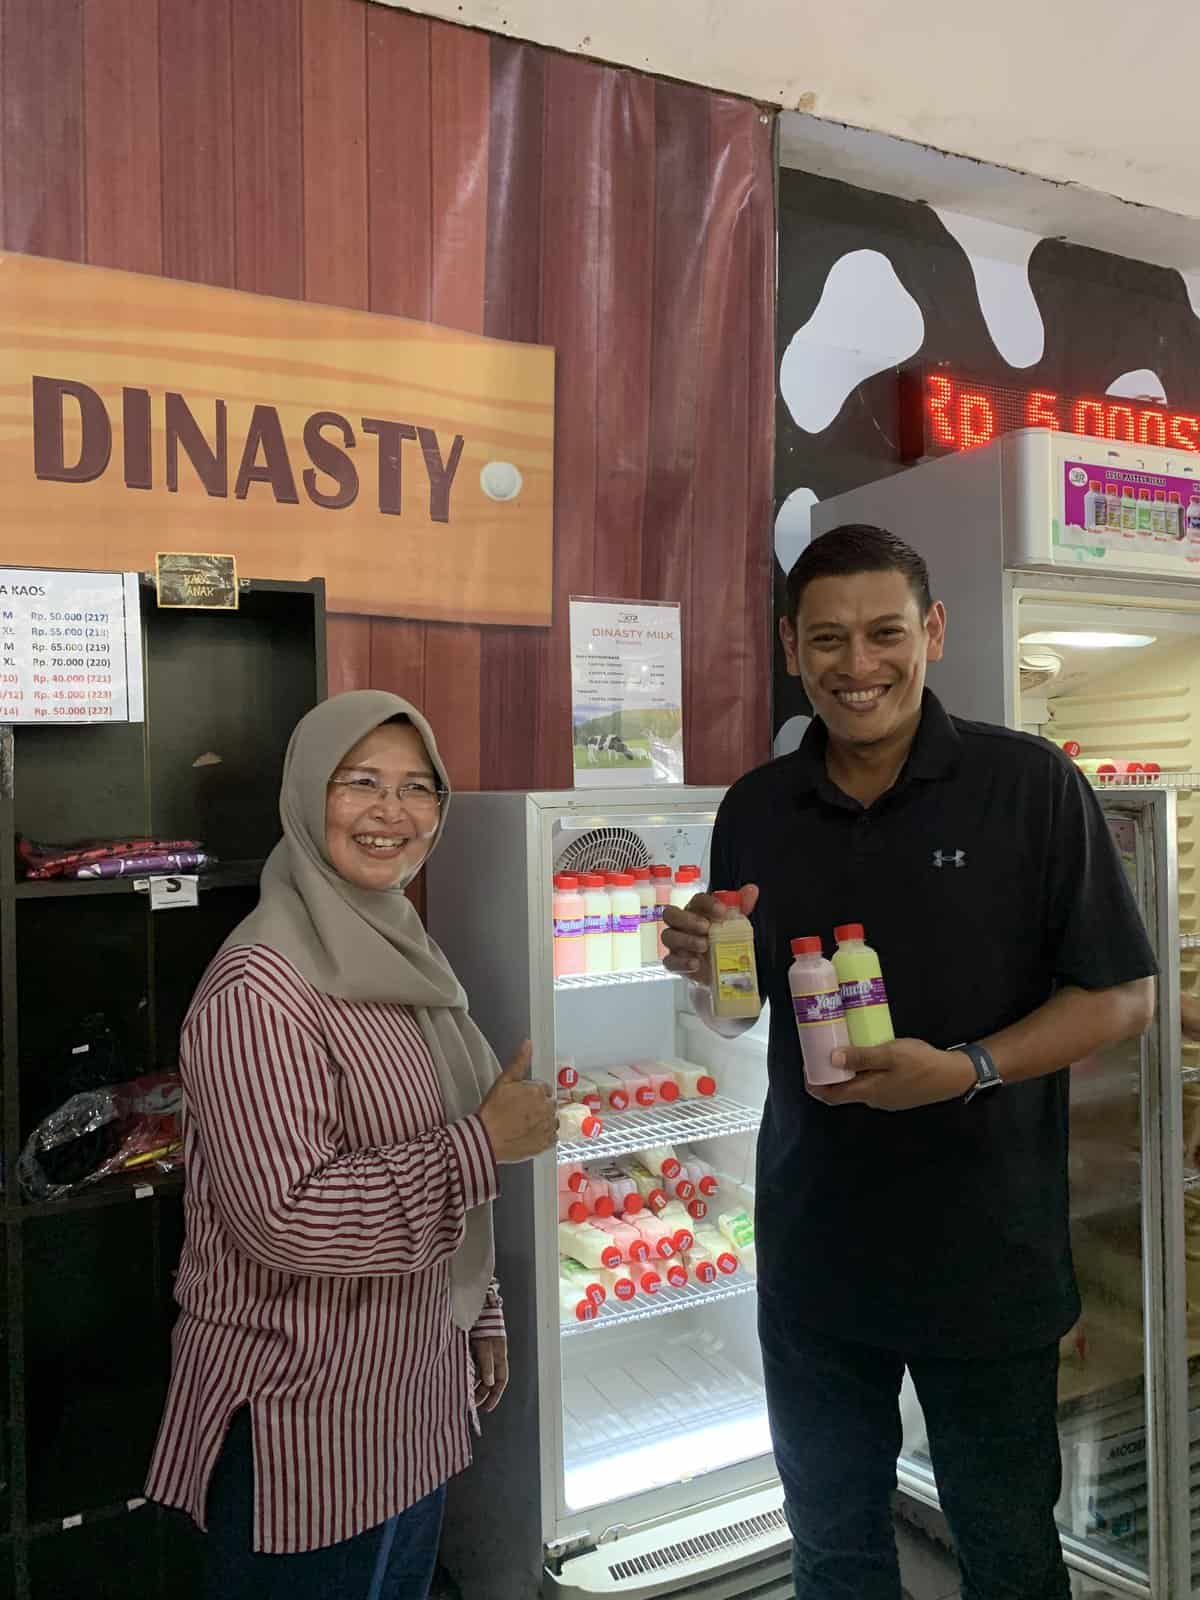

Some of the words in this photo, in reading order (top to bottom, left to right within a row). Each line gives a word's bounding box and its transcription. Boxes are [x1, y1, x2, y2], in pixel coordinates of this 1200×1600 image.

[32, 375, 464, 523] DINASTY
[11, 585, 46, 597] KAOS
[2, 611, 14, 620] M
[49, 612, 82, 622] 50.000
[84, 613, 109, 624] (217)
[591, 627, 642, 639] DINASTY
[646, 630, 673, 640] MILK
[3, 642, 15, 651] M
[85, 644, 110, 655] (219)
[3, 657, 16, 666] XL
[51, 658, 84, 667] 70.000
[86, 659, 111, 670] (220)
[53, 706, 86, 717] 50.000
